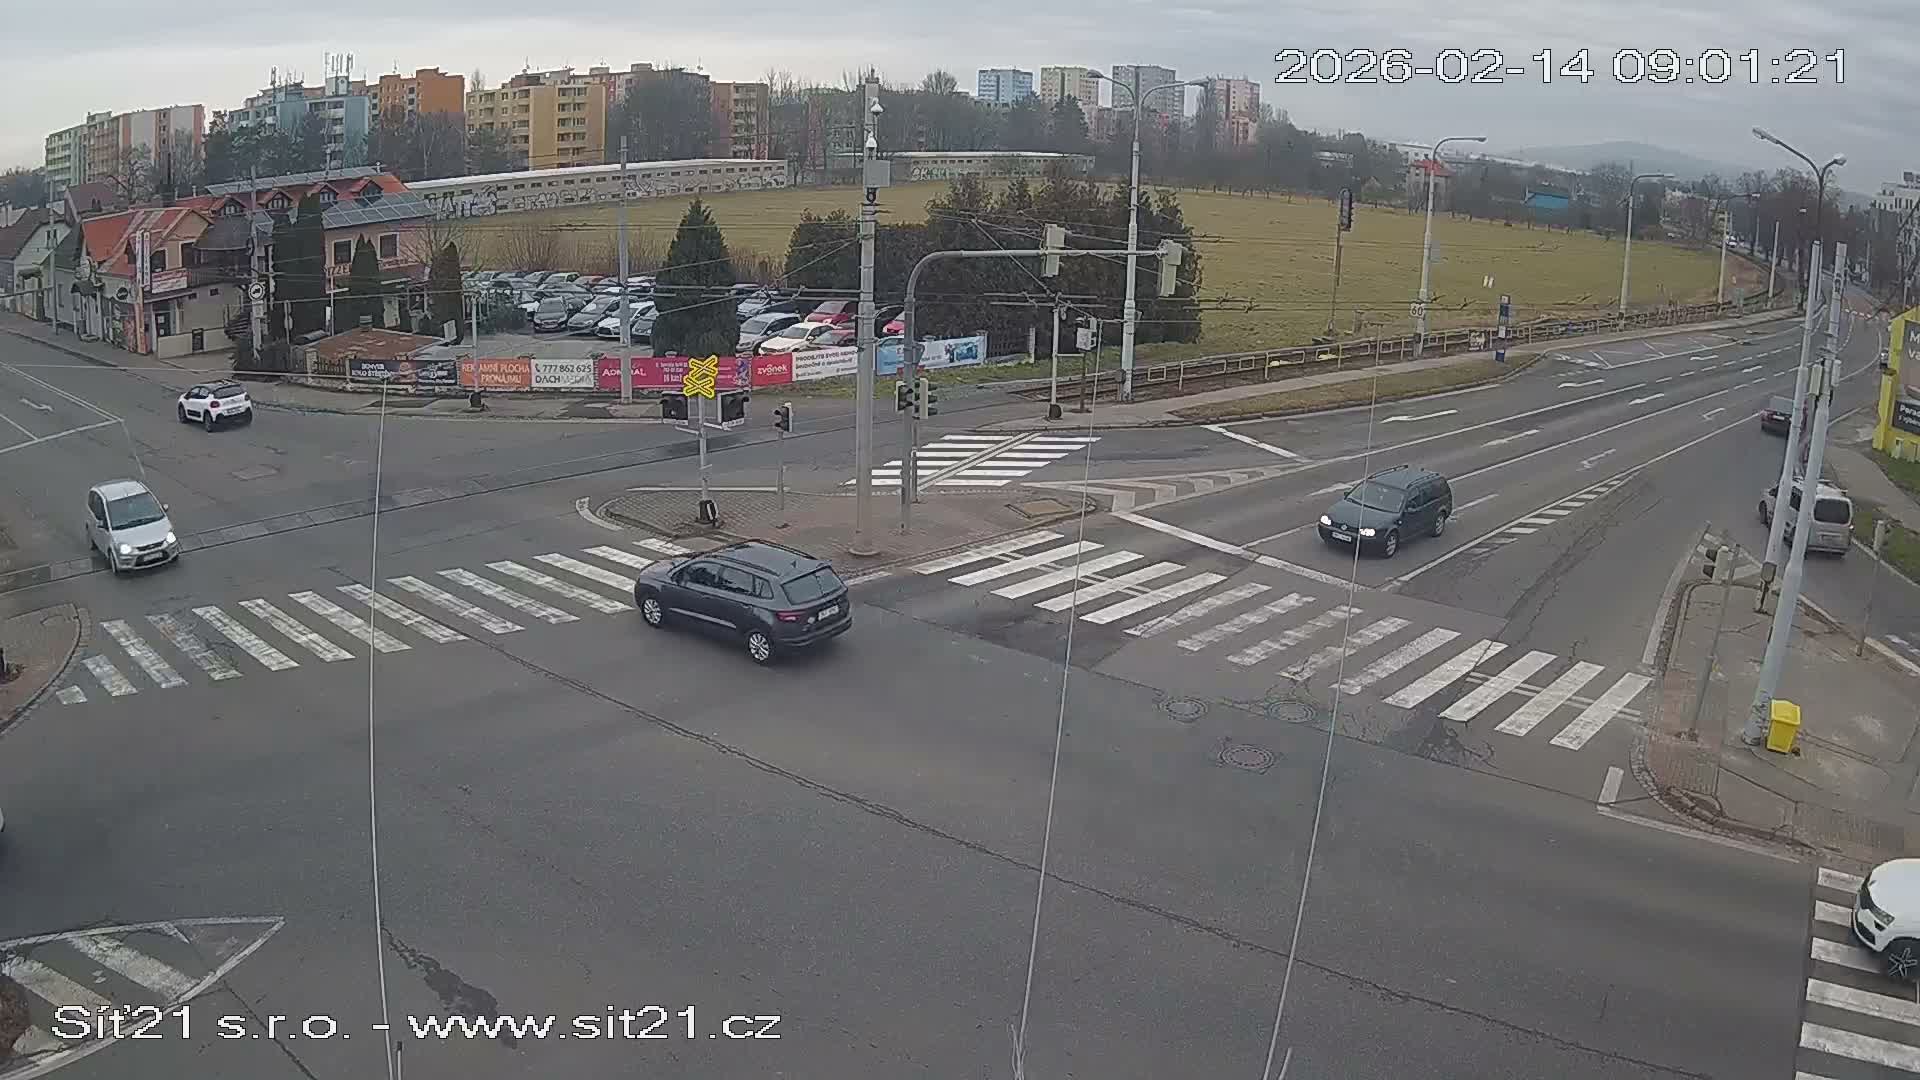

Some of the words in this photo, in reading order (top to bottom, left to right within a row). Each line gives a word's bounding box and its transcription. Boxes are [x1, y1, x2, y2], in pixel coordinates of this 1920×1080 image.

[1411, 306, 1424, 316] 60
[542, 364, 558, 373] 777
[559, 364, 575, 373] 862
[576, 364, 592, 373] 625
